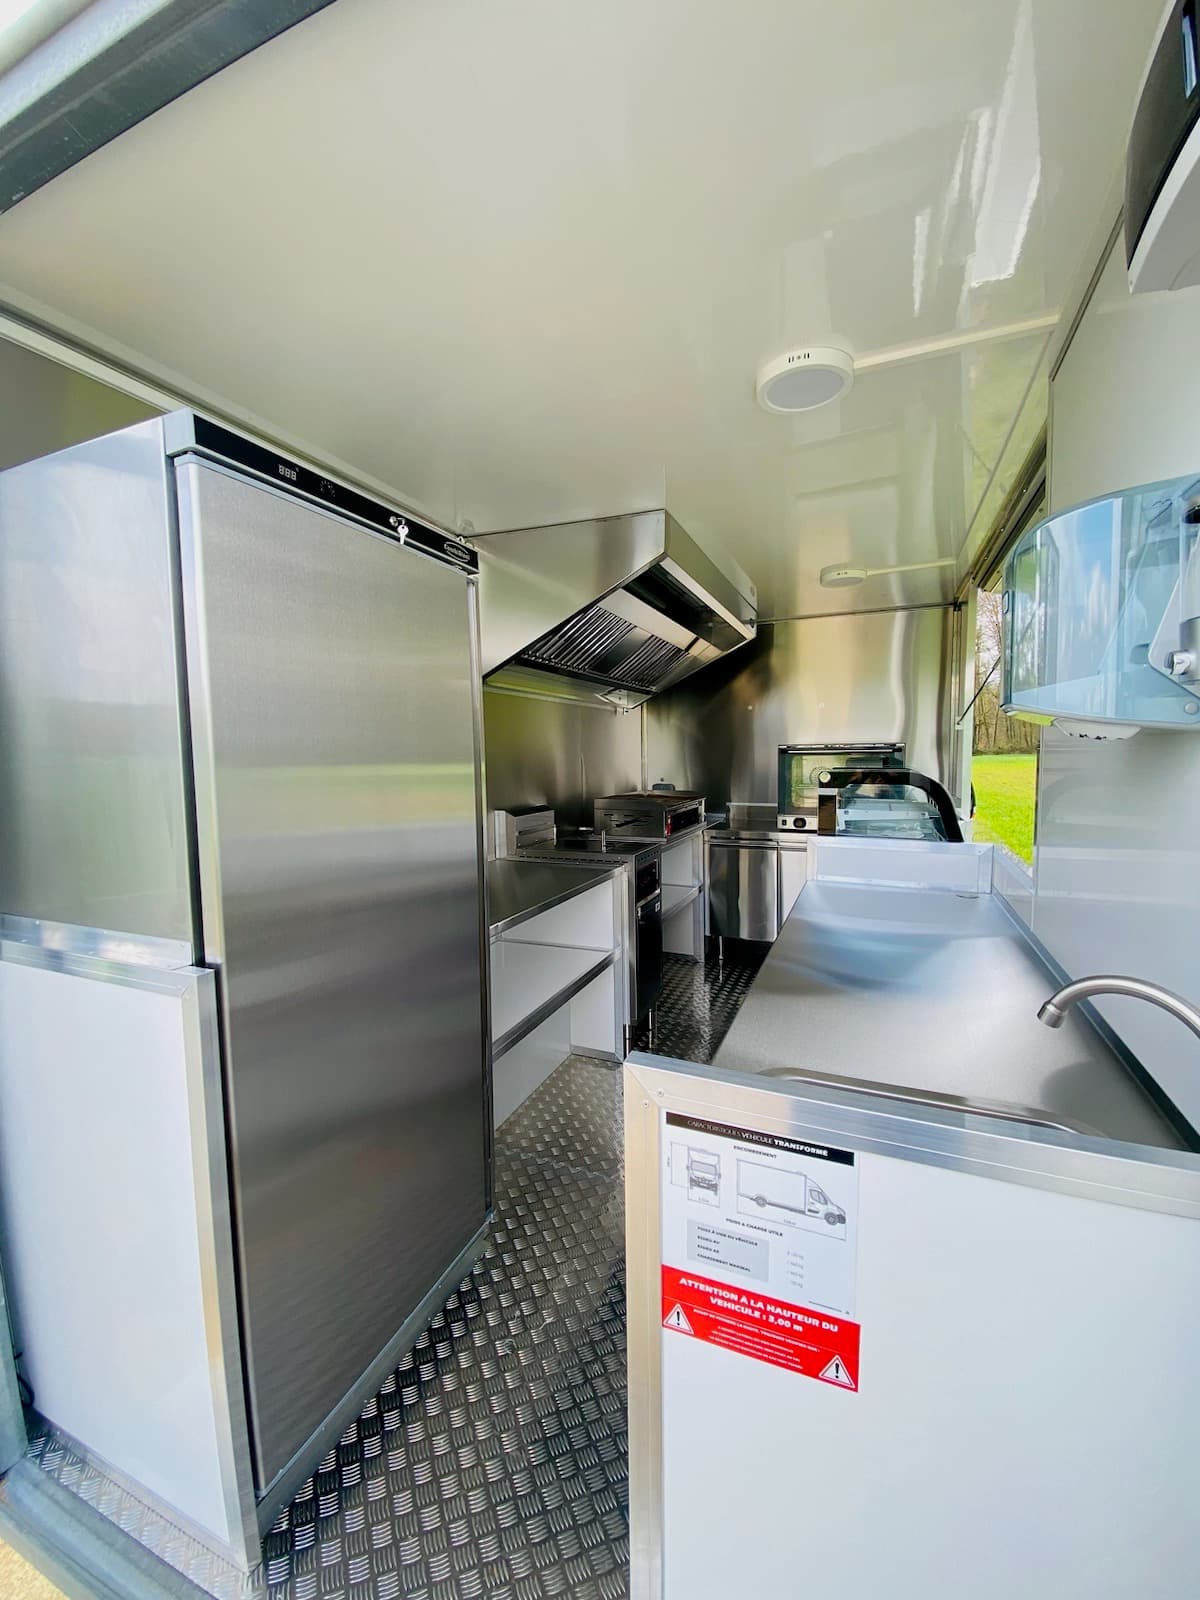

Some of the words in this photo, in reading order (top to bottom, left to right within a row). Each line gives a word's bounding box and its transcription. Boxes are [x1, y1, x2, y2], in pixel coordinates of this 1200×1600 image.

[679, 1277, 739, 1302] ATTENTION
[750, 1298, 765, 1310] LA
[766, 1304, 820, 1327] HAUTEUR
[821, 1321, 839, 1333] DU
[709, 1296, 761, 1319] VEHICULE
[768, 1315, 792, 1328] 3,00
[792, 1323, 804, 1333] m
